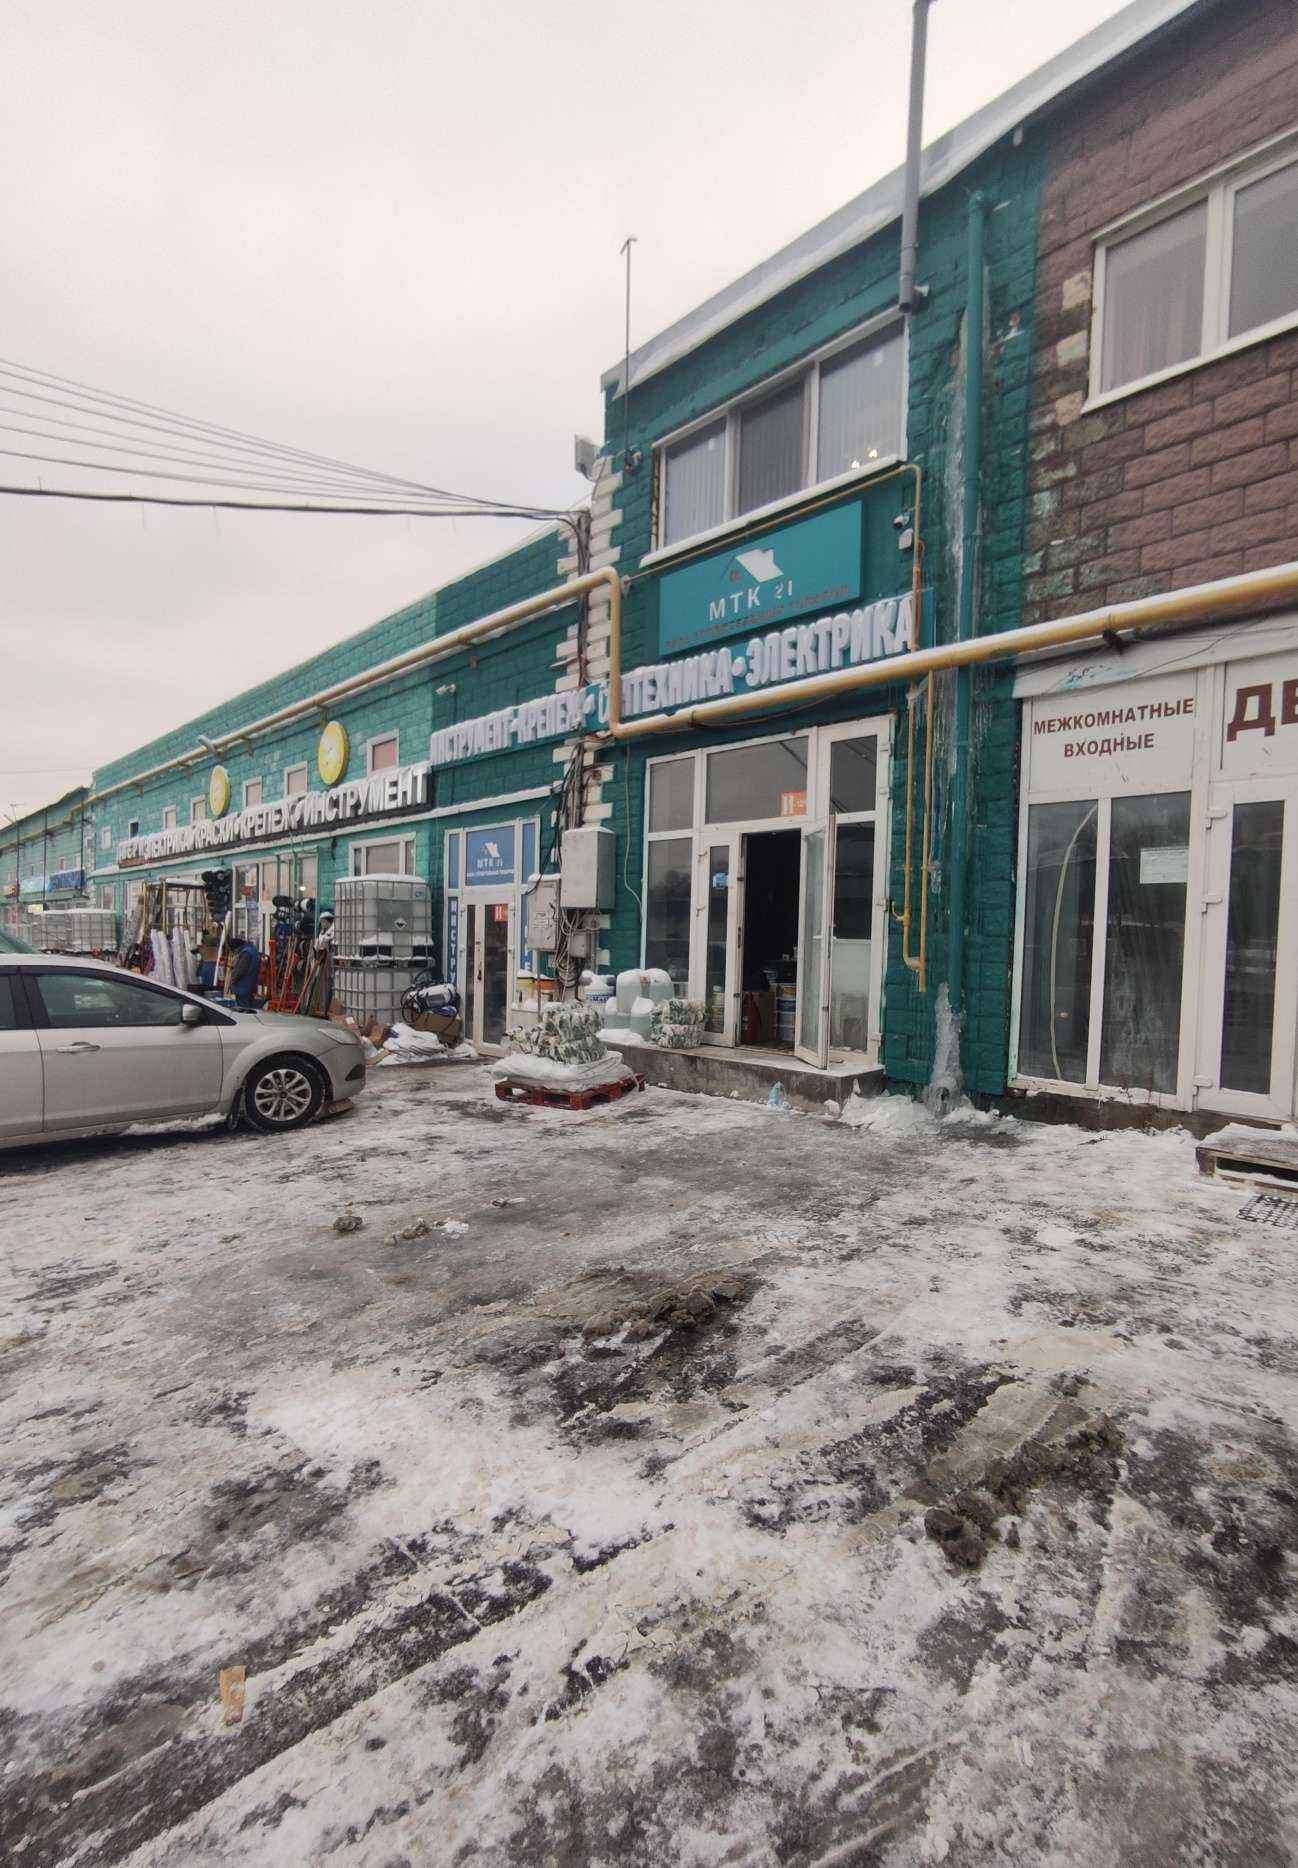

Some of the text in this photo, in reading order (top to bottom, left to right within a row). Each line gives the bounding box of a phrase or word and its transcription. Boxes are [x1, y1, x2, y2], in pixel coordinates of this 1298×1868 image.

[708, 586, 761, 621] МТК
[774, 580, 793, 600] 21
[598, 646, 733, 724] СНТЕХНИКА
[745, 596, 914, 686] ЭЛЕКТРИКА
[1033, 698, 1194, 736] МЕЖКОМНАТНЫЕ
[1063, 733, 1155, 758] ВХОДНЫЕ
[303, 766, 430, 826] ИНСТРУМЕНТ
